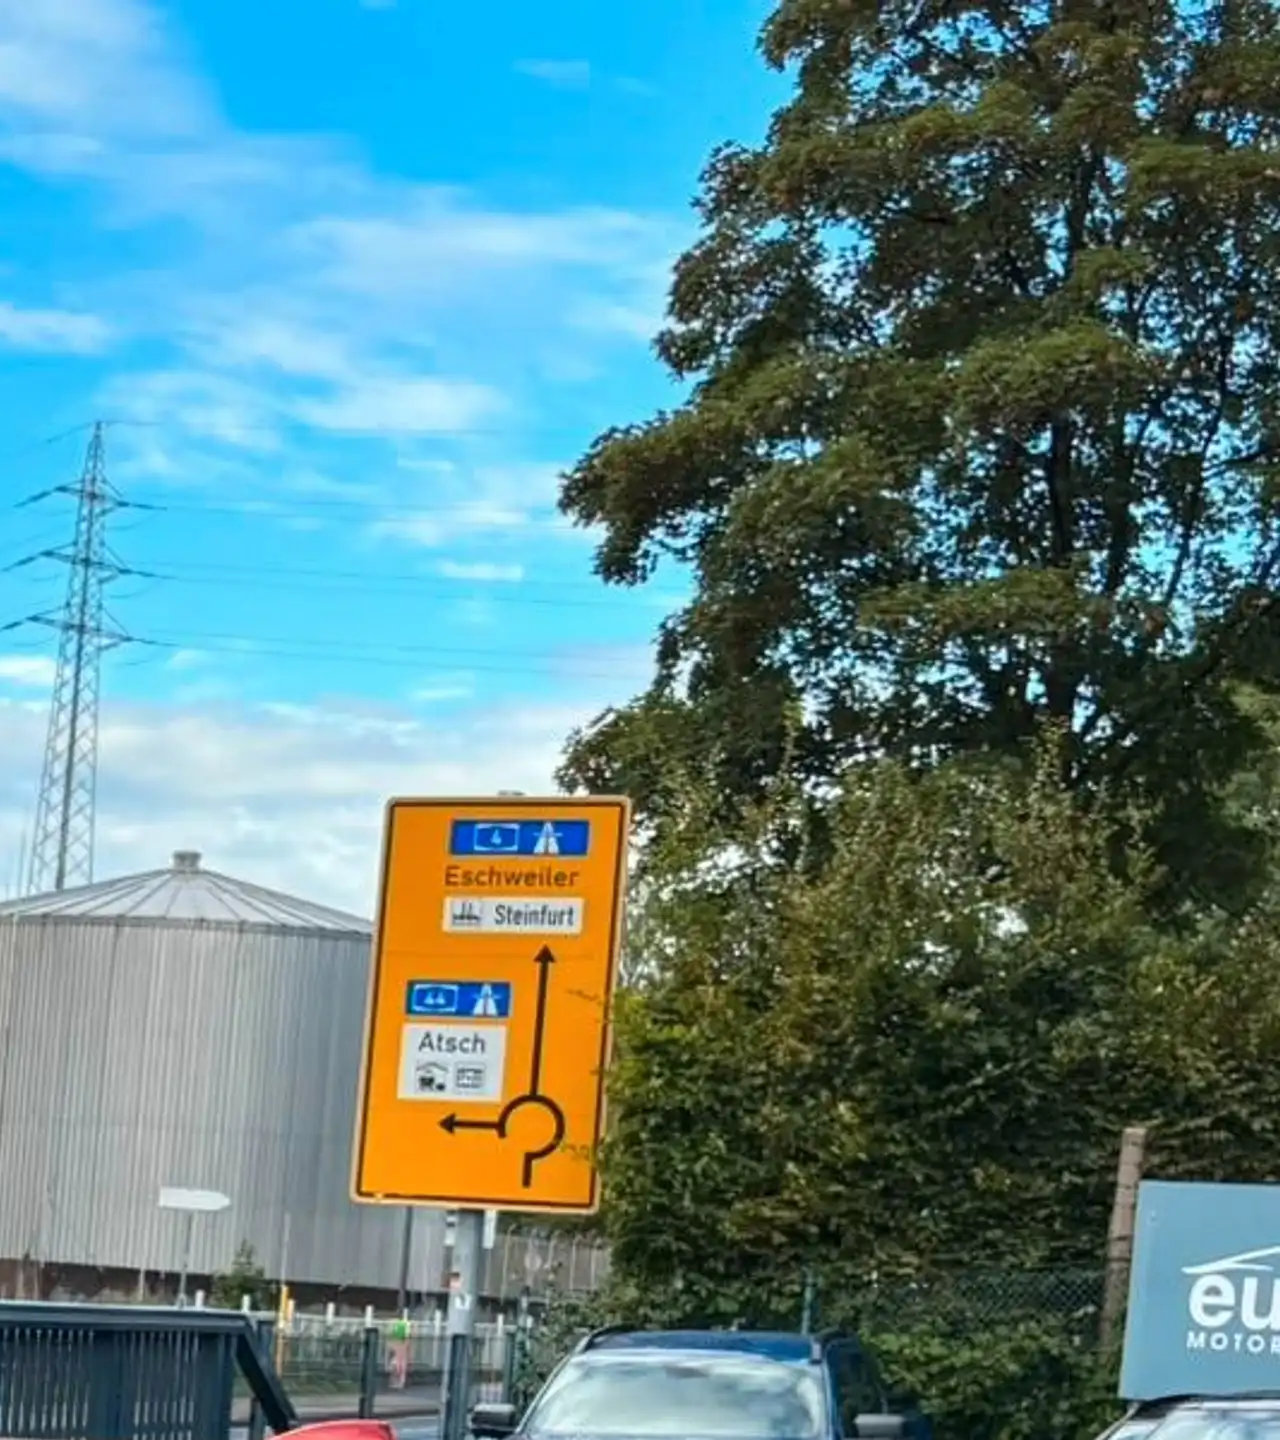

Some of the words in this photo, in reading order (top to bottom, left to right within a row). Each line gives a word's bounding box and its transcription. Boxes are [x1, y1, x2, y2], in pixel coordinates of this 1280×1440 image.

[444, 864, 580, 888] Eschweiler
[494, 903, 576, 926] Steinfurt
[418, 1031, 486, 1054] Atsch
